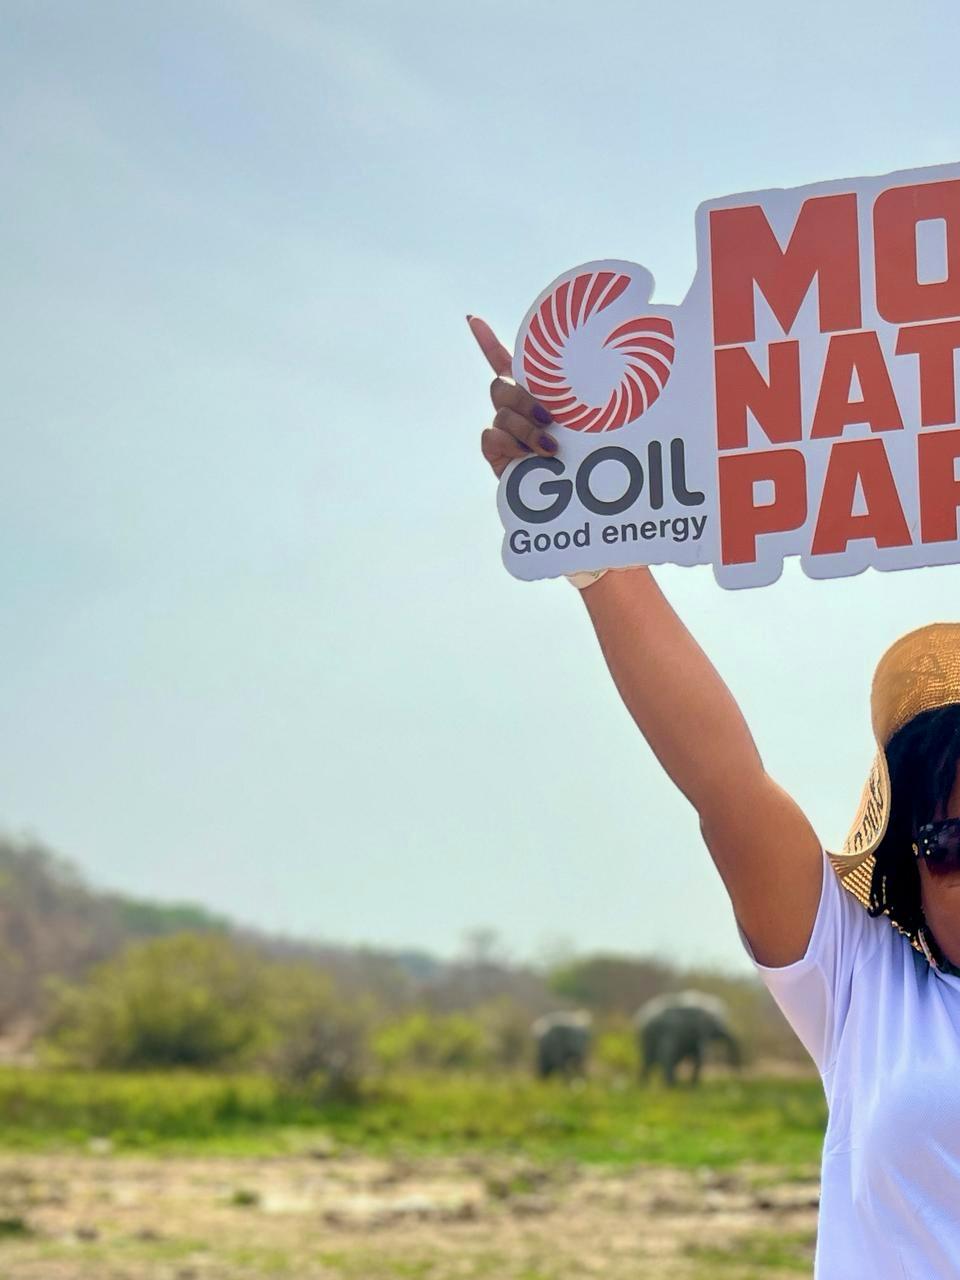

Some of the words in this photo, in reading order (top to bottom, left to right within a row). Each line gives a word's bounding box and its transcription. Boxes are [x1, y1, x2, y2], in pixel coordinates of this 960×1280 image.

[505, 436, 706, 523] GOIL
[509, 519, 591, 556] Good
[600, 513, 708, 551] energy
